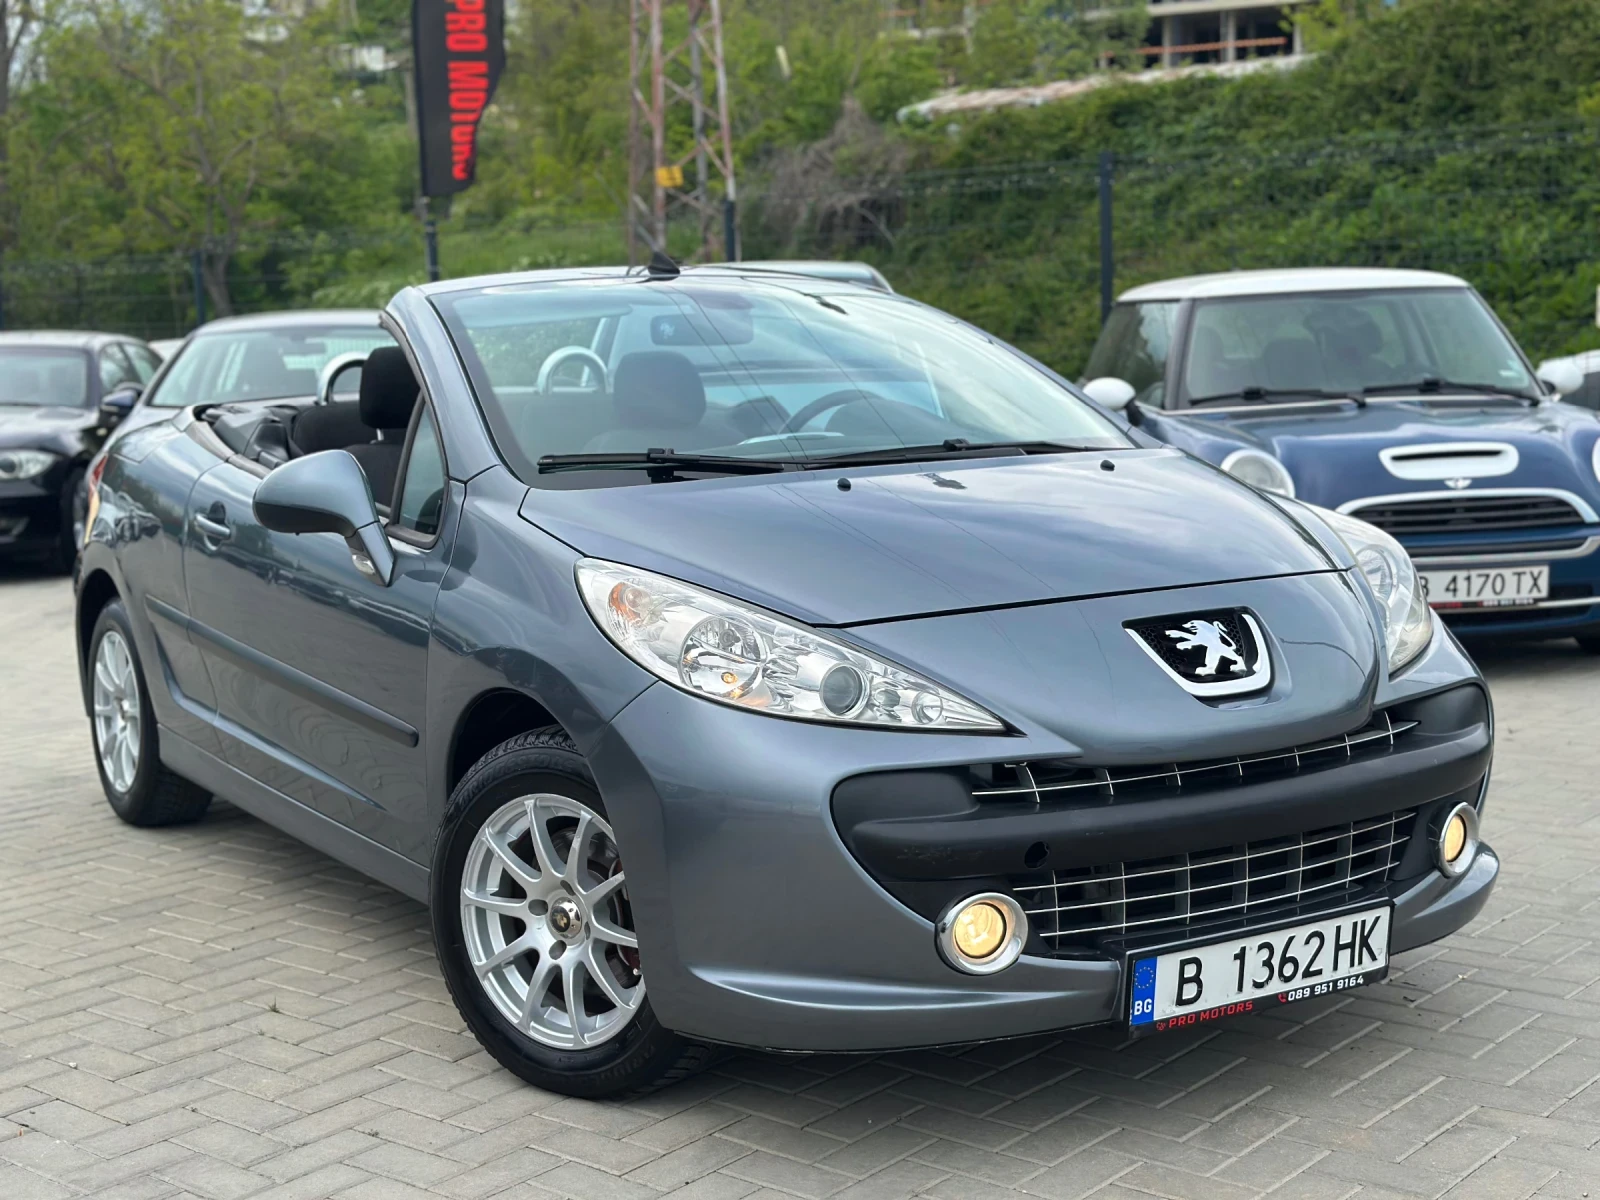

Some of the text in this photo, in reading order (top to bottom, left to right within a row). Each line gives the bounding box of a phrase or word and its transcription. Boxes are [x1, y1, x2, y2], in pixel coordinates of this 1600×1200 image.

[445, 0, 488, 51] PRO
[1445, 574, 1506, 598] 4170
[1512, 570, 1543, 595] TX
[1175, 915, 1382, 1007] B 1362 HK
[1287, 975, 1364, 1001] 089 951 9164
[1133, 998, 1153, 1016] BG
[1168, 1000, 1253, 1029] PRO MOTORS
